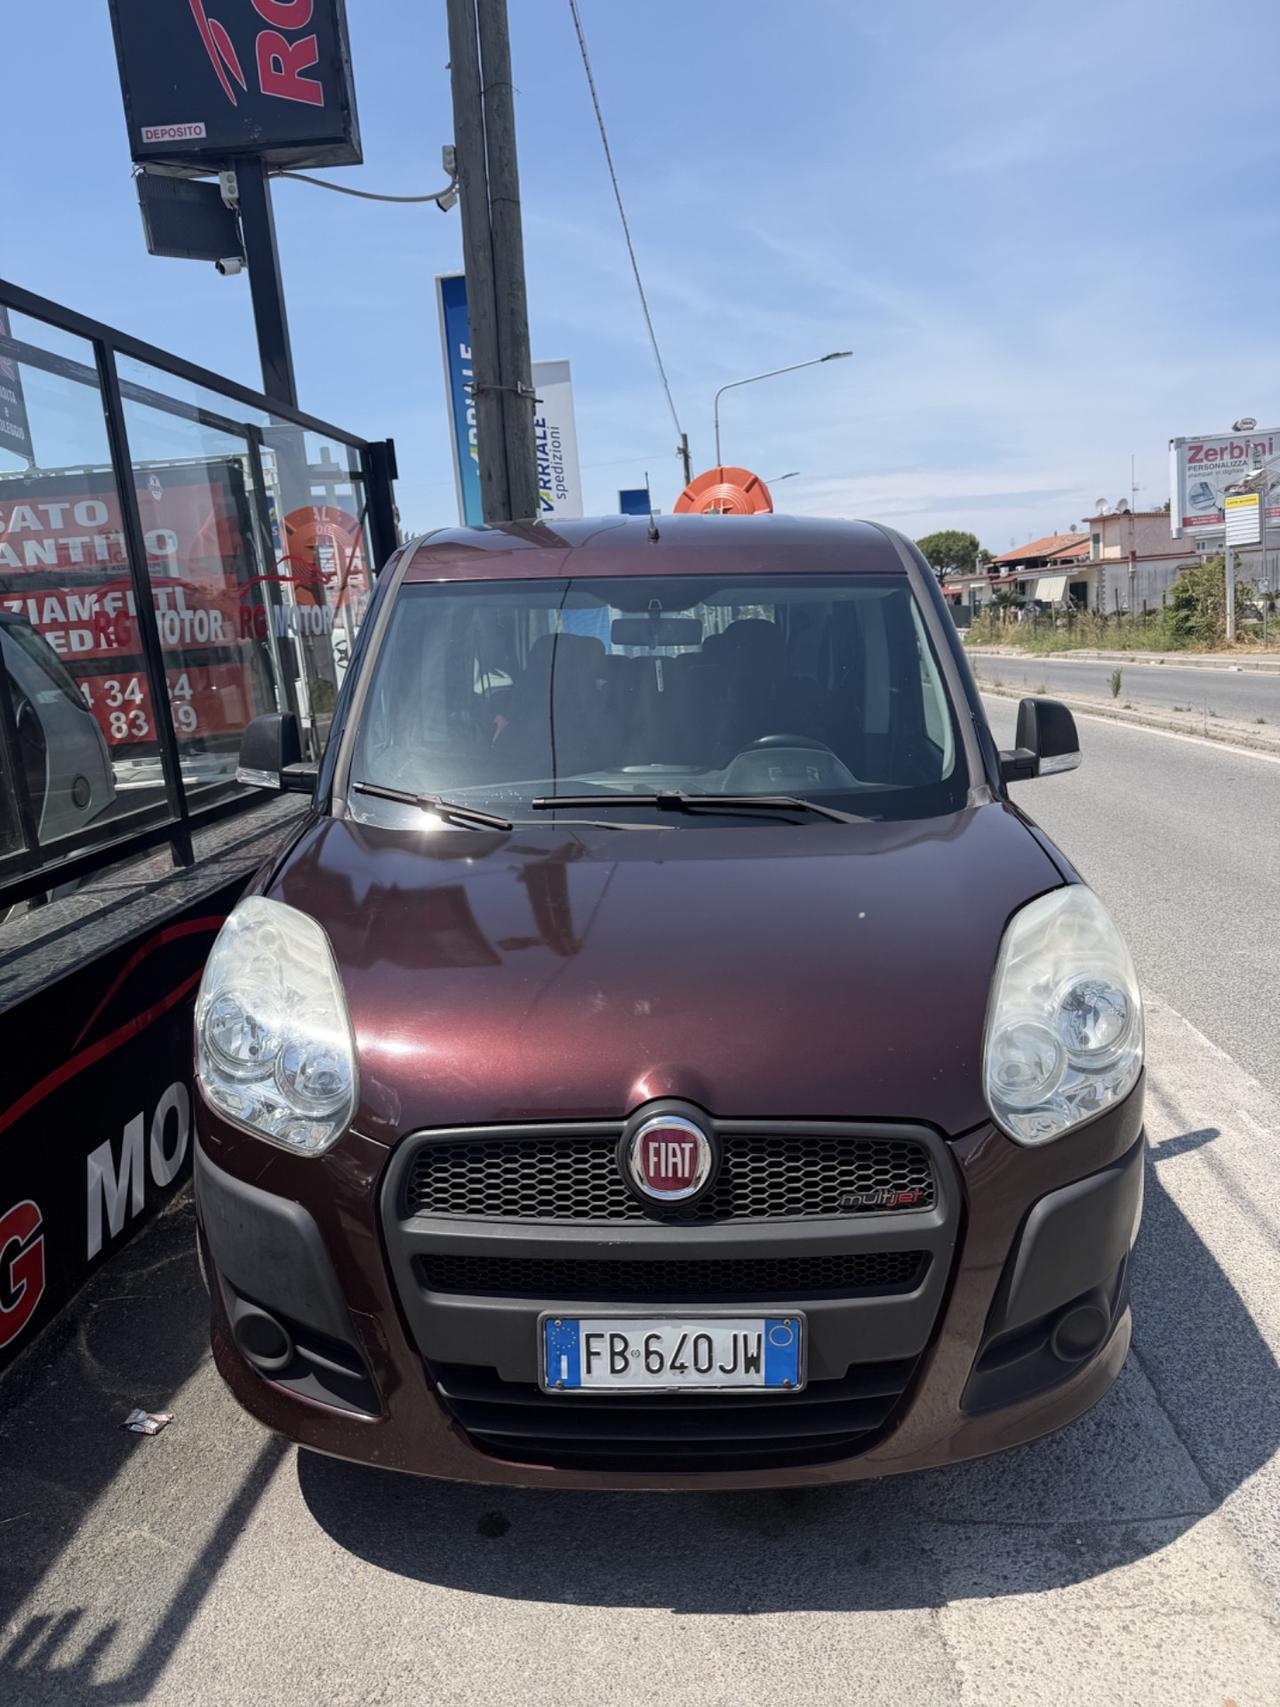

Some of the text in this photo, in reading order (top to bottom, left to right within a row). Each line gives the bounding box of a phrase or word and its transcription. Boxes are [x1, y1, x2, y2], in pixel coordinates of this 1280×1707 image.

[144, 124, 203, 140] DEPOSITO
[550, 425, 568, 500] spedizioni
[1187, 437, 1274, 464] Zerbini
[1188, 460, 1249, 472] PERSONALIZZA
[0, 500, 109, 533] ATO
[273, 604, 333, 638] MOTOR
[104, 677, 144, 707] 34
[109, 710, 149, 739] 83
[648, 1142, 694, 1179] FIAT
[840, 1187, 924, 1208] multijet
